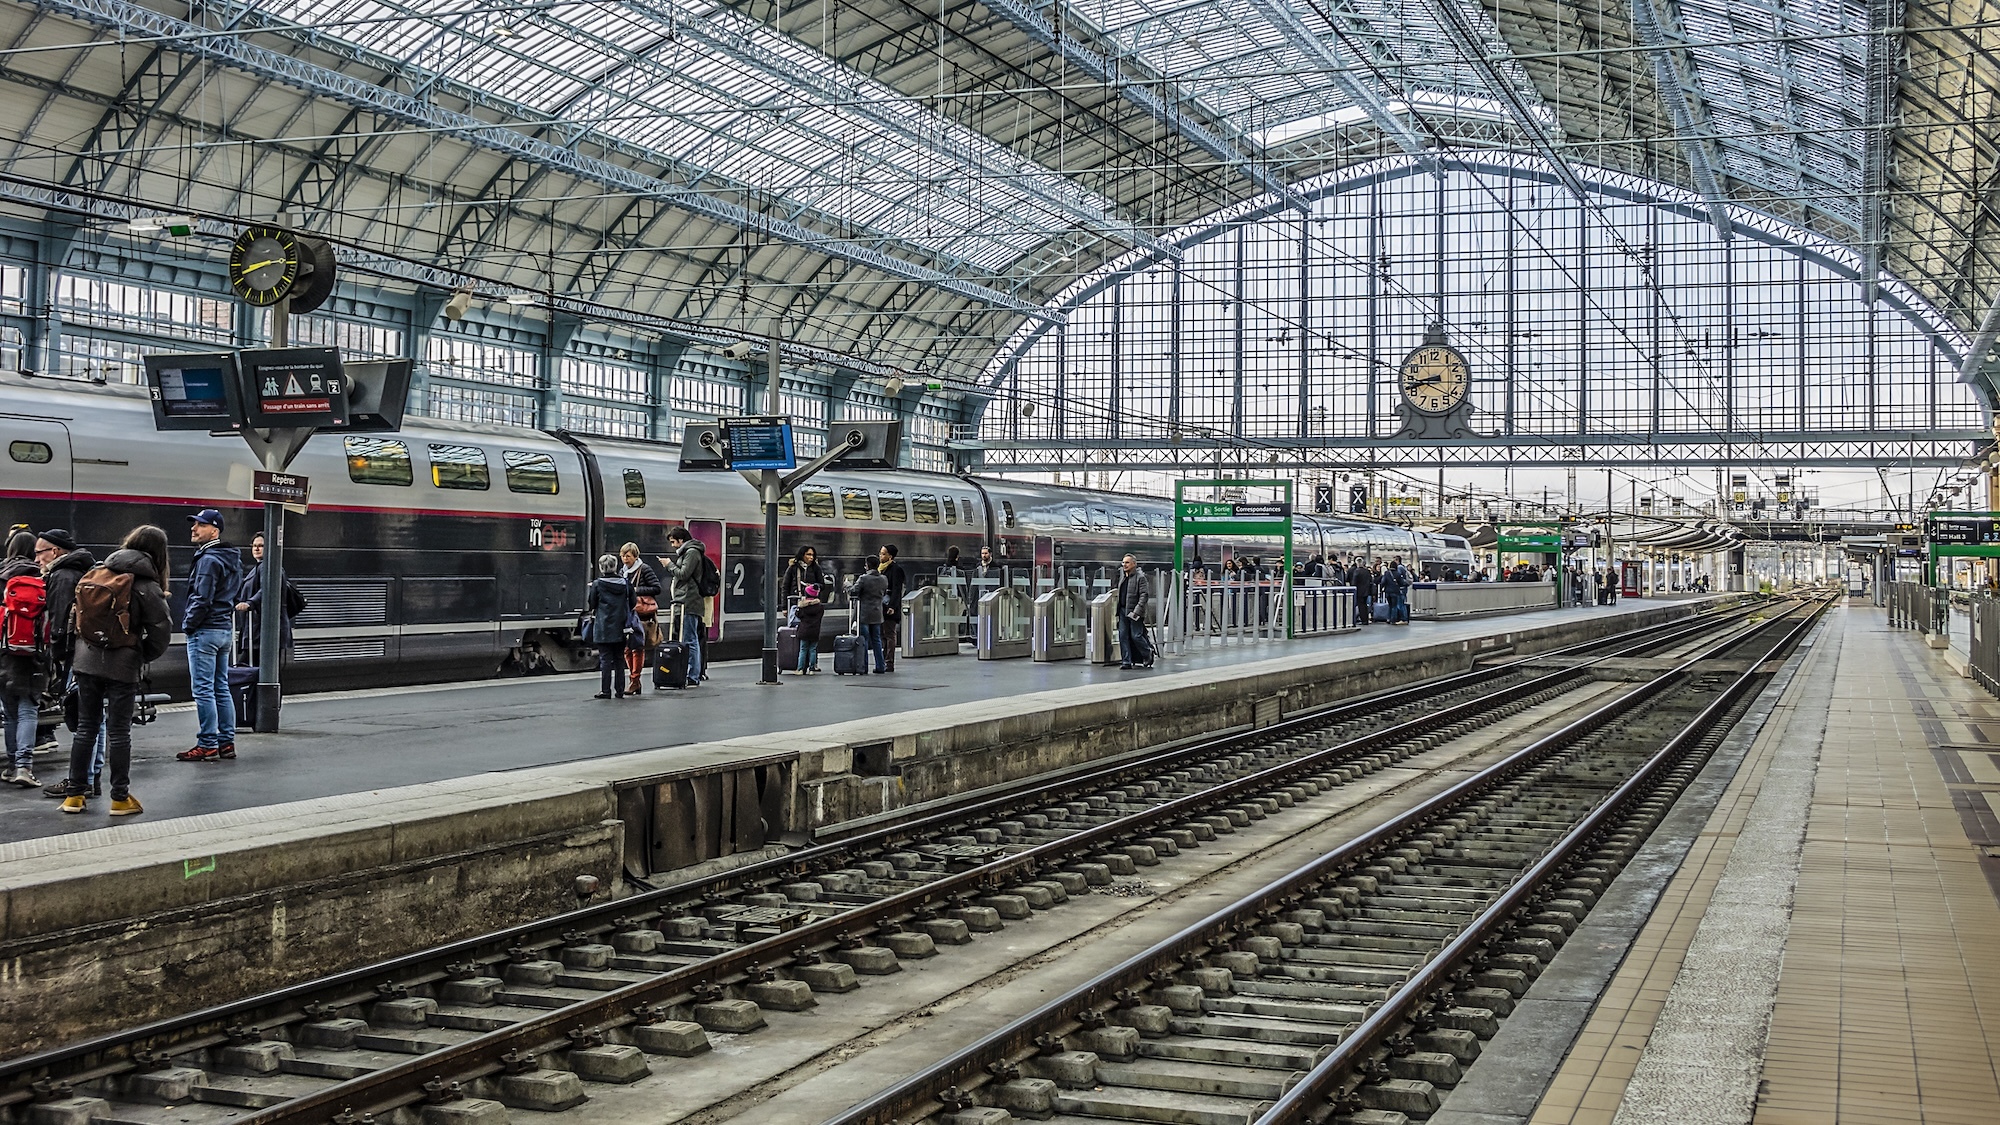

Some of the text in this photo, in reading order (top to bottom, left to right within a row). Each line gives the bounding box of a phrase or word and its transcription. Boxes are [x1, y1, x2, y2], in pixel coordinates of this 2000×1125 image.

[1420, 354, 1427, 364] 11
[1430, 352, 1439, 360] 12
[1445, 354, 1448, 364] 1
[1410, 364, 1418, 373] 10
[1452, 364, 1458, 372] 2
[1456, 374, 1462, 384] 3
[1411, 388, 1417, 396] 8
[1451, 386, 1457, 396] 4
[1420, 396, 1427, 406] 7
[1432, 398, 1438, 408] 6
[1443, 396, 1449, 404] 5
[272, 474, 295, 485] Repères
[1319, 491, 1329, 503] X
[1353, 491, 1363, 504] X
[530, 519, 542, 527] TGV
[732, 562, 745, 596] 2
